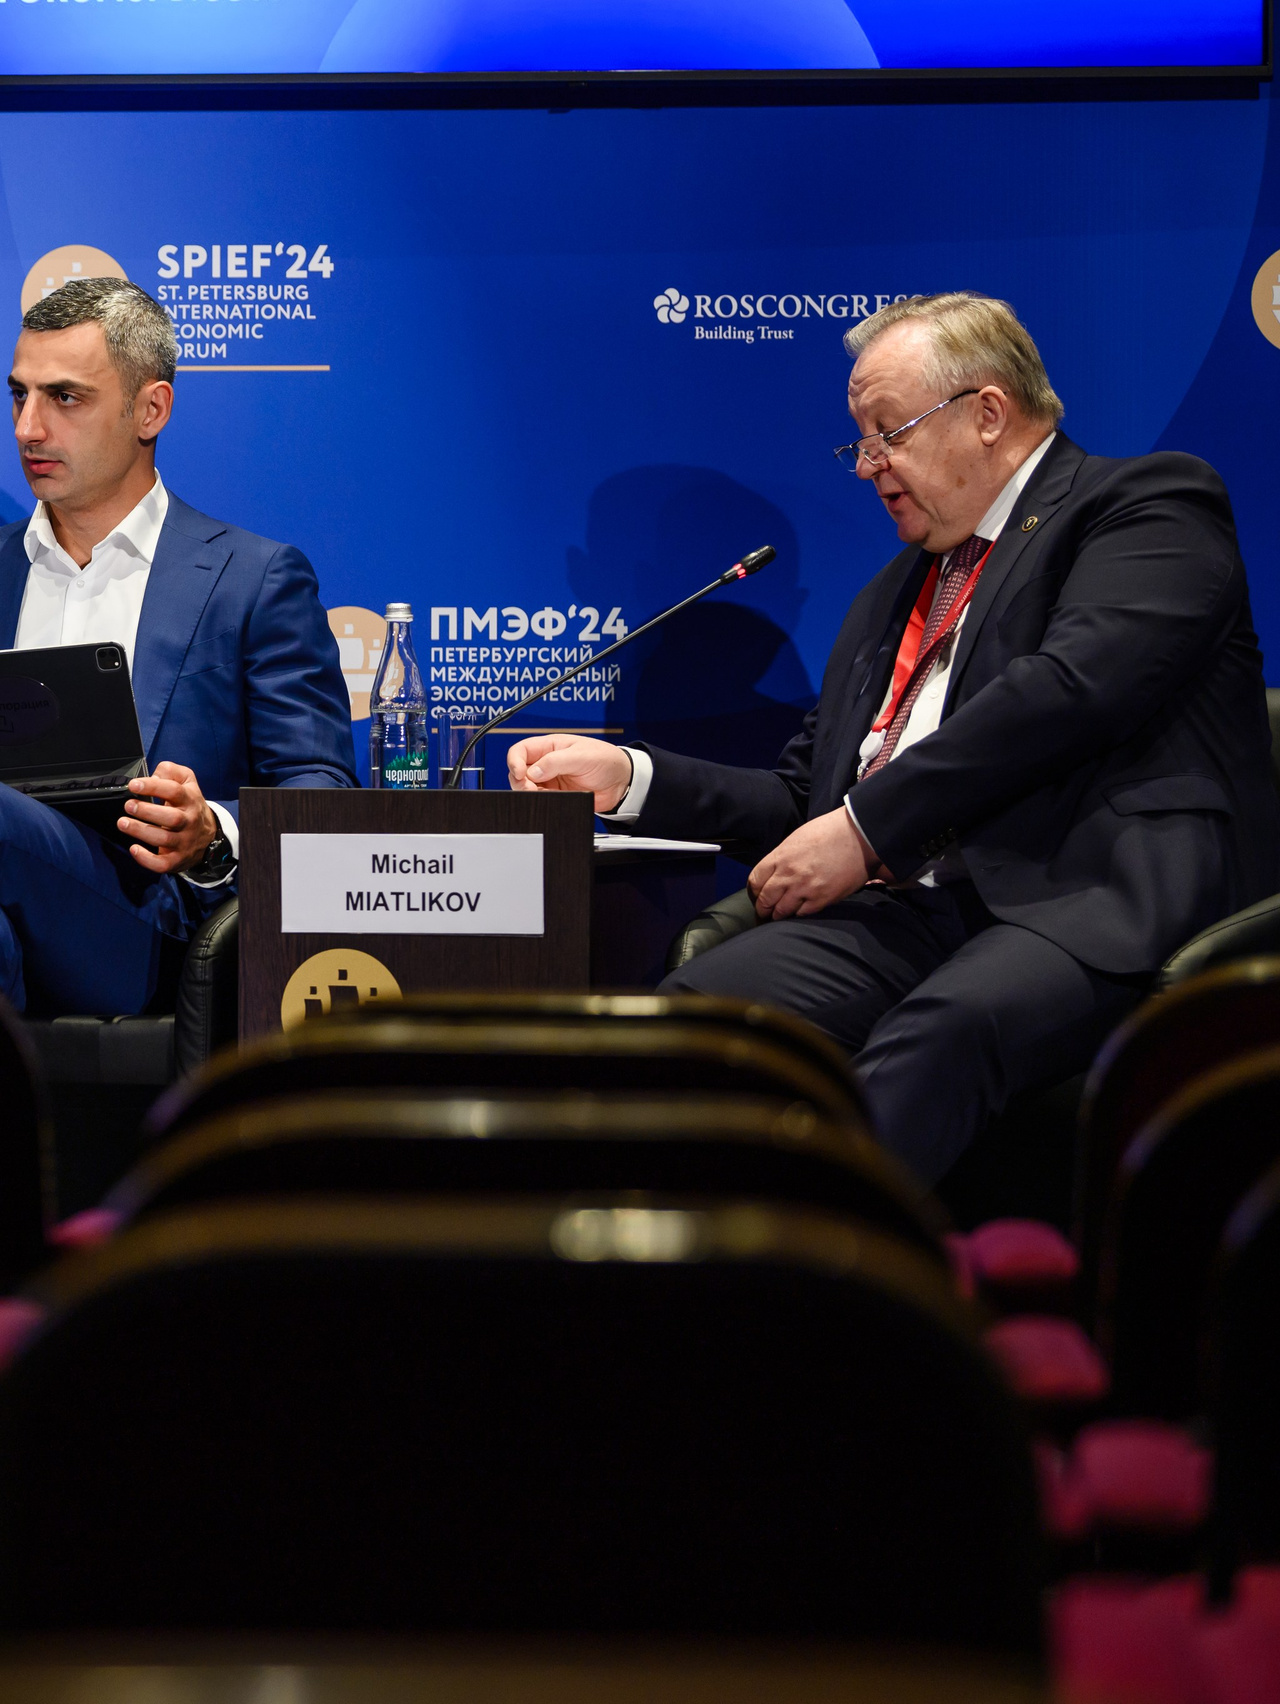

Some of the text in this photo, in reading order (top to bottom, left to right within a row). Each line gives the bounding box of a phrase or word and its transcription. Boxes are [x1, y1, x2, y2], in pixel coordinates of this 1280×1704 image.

[157, 284, 310, 300] ST. PETERSBURG
[163, 304, 316, 319] NTERNATIONAL
[694, 326, 794, 344] Building Trust
[430, 644, 593, 663] ПЕТЕРБУРГСКИЙ
[371, 854, 454, 874] Michail
[345, 891, 481, 912] MIATLIKOV
